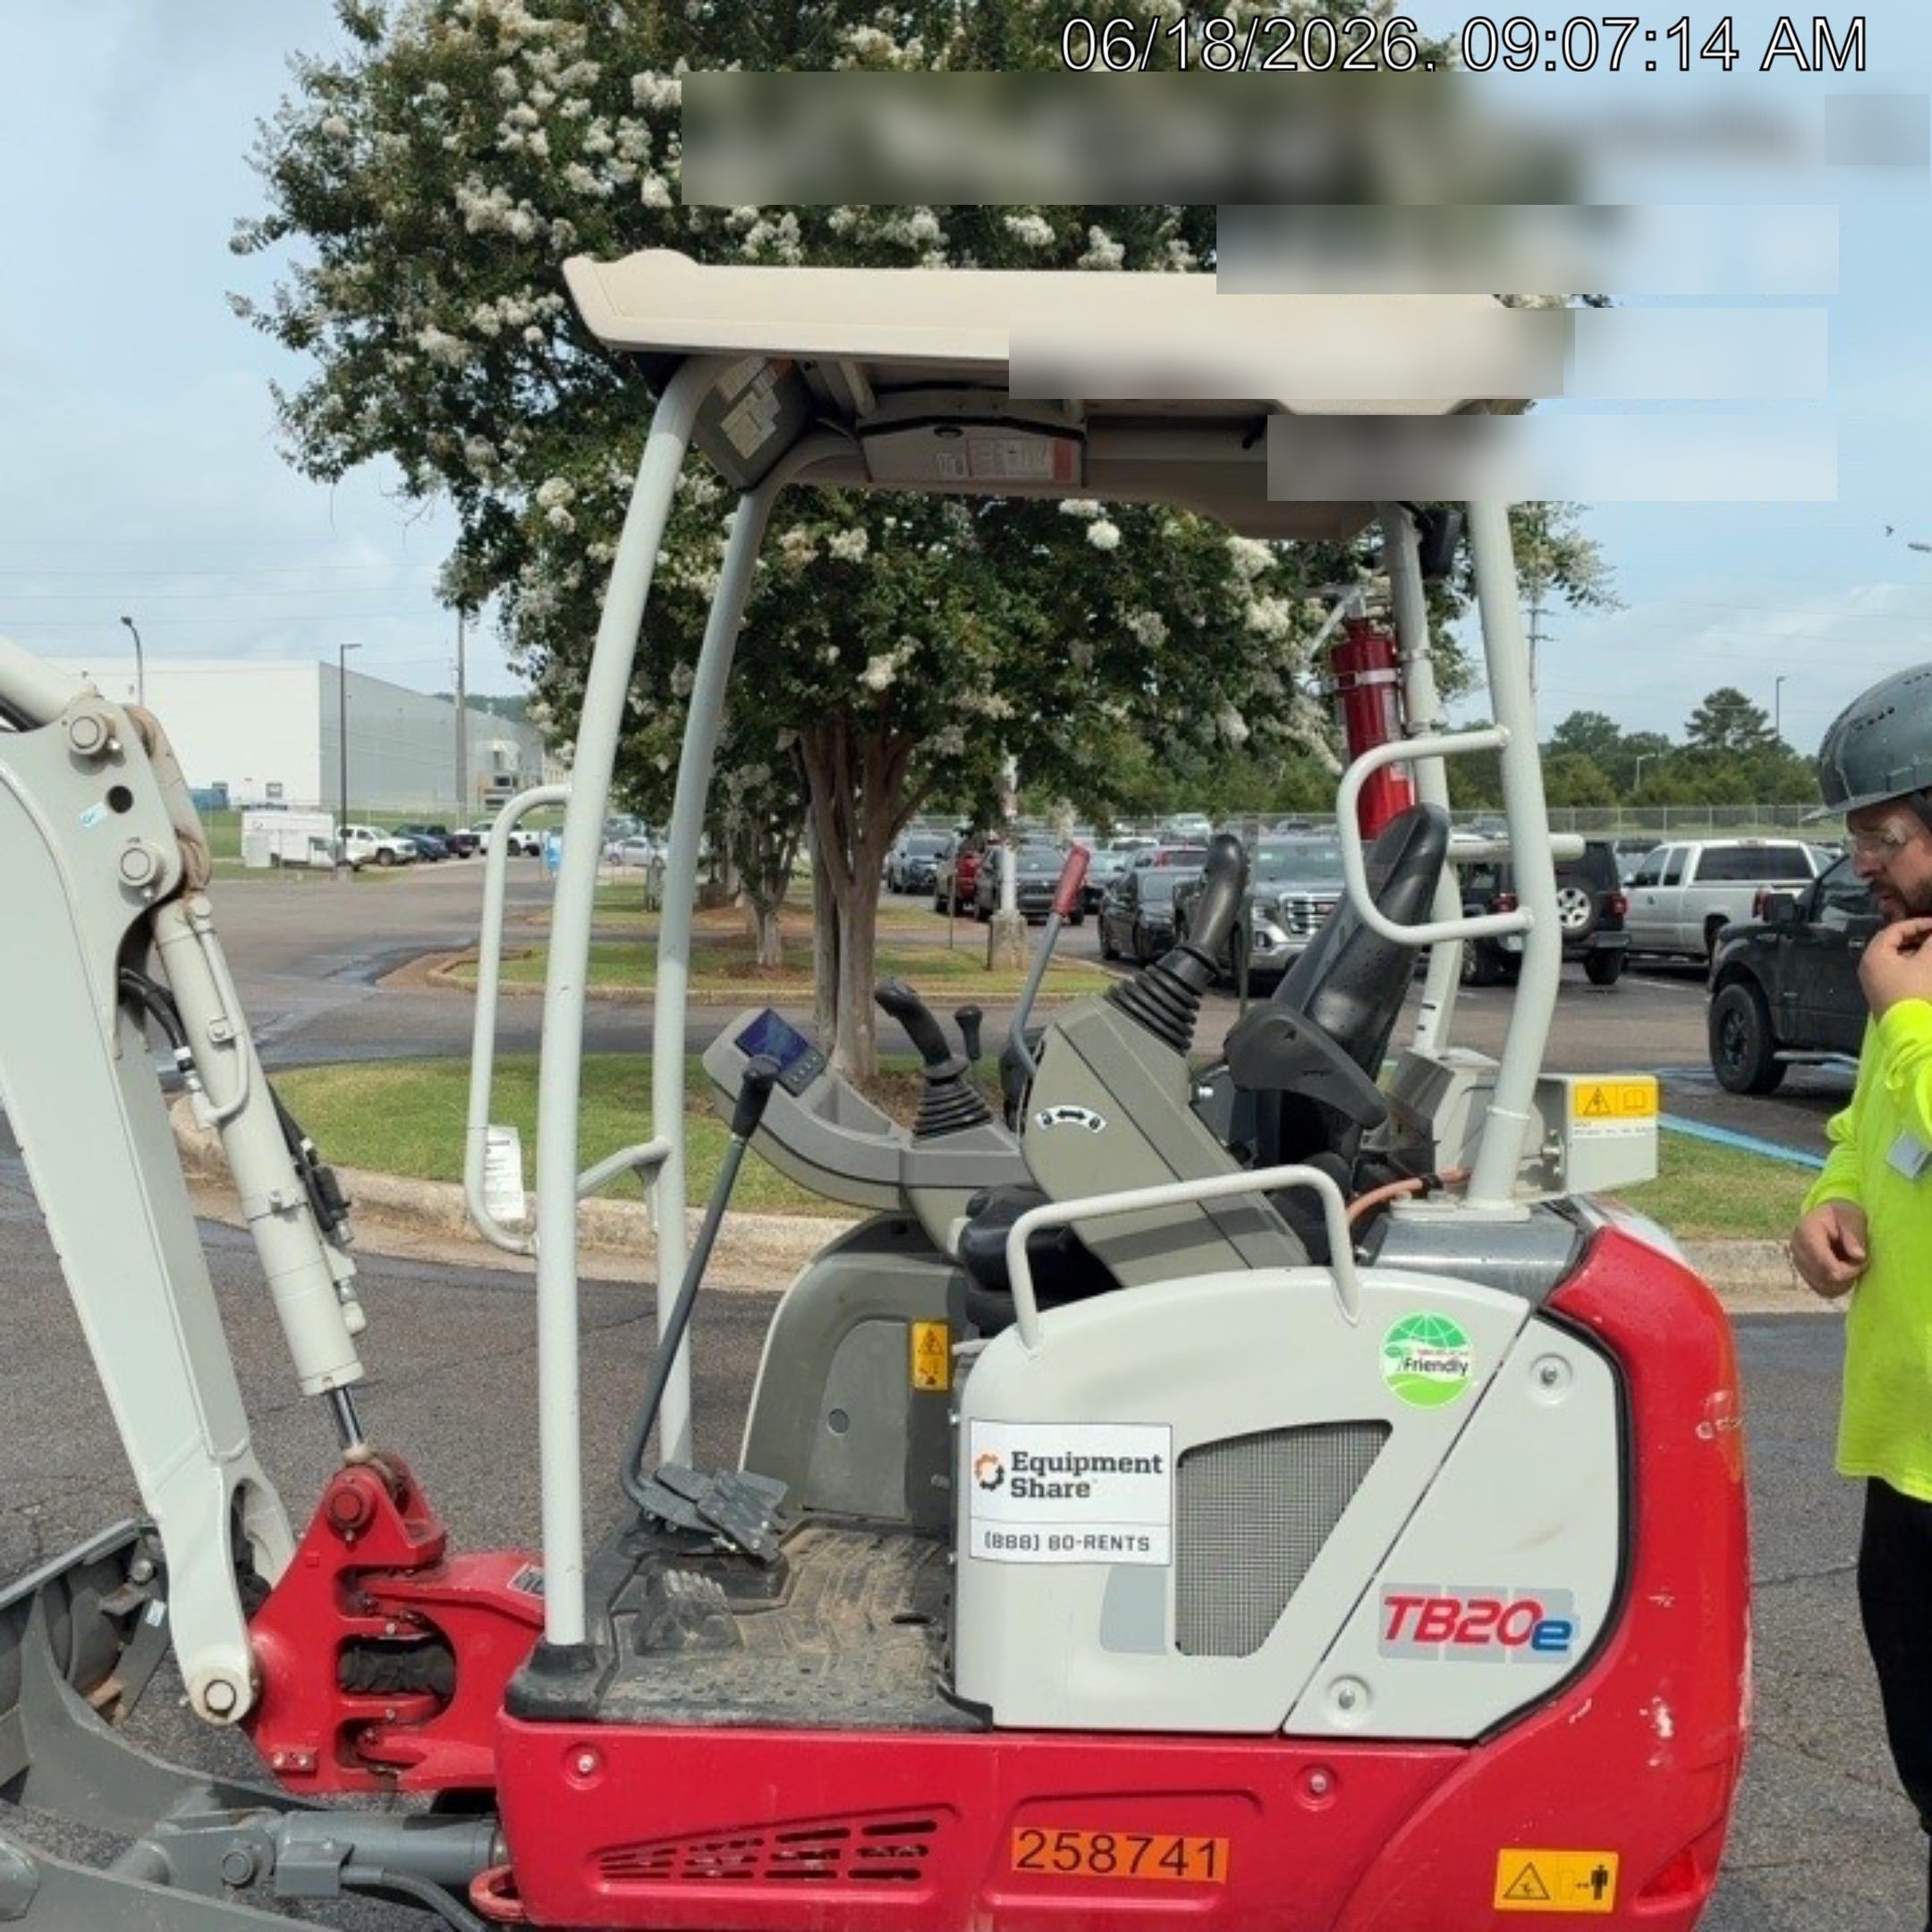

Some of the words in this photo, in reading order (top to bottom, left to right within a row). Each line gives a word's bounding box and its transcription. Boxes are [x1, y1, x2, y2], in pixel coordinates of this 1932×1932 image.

[1403, 1356, 1469, 1377] Friendly
[1011, 1451, 1164, 1477] Equipment
[1011, 1478, 1091, 1498] Share
[1048, 1534, 1150, 1552] 80-RENTS
[1385, 1596, 1573, 1651] TB20e
[1017, 1829, 1216, 1878] 258741
